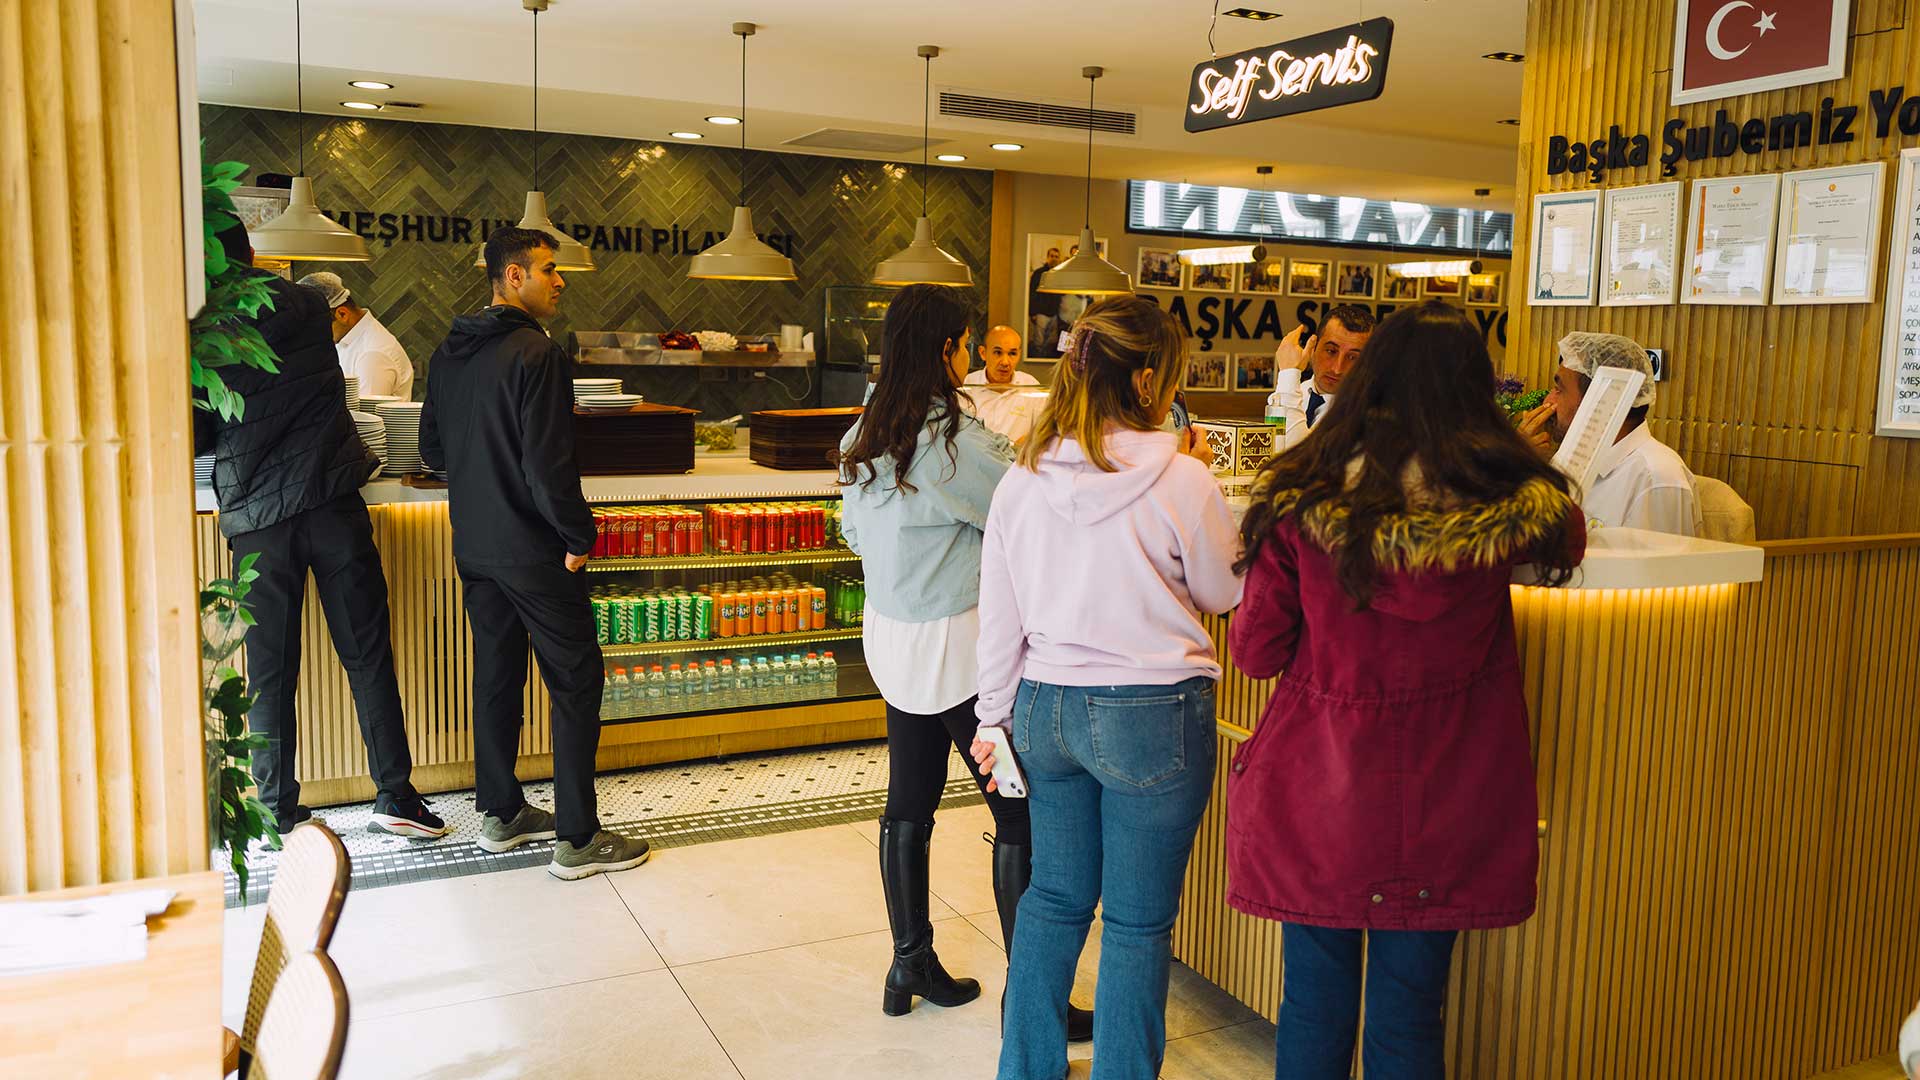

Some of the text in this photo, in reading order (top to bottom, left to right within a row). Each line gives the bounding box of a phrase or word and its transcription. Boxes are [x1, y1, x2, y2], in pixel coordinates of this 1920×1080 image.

[1190, 35, 1379, 120] Self Servis
[1547, 125, 1650, 184] Başka
[1904, 333, 1917, 342] AZ
[1897, 404, 1911, 414] SU
